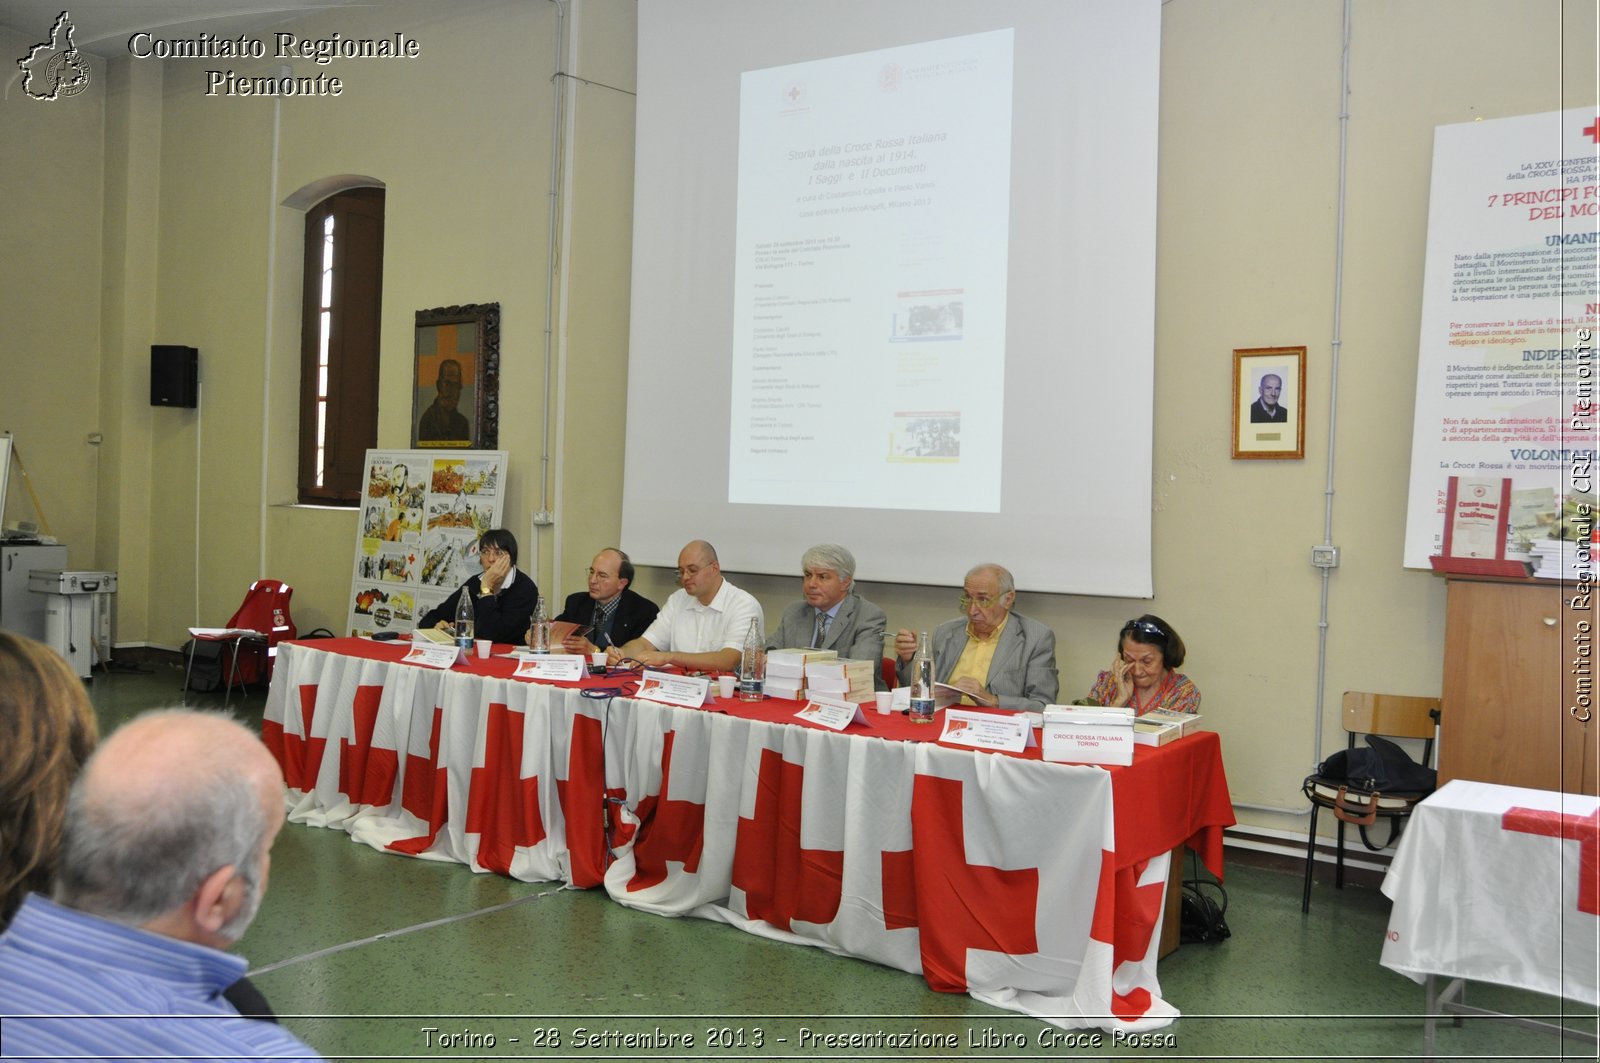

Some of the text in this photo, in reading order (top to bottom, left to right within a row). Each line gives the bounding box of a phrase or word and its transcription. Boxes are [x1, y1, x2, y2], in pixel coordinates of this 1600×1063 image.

[788, 132, 947, 160] Storia della Croce Rossa Italiana
[813, 159, 836, 171] dalla
[839, 155, 873, 168] nascita
[876, 154, 886, 163] al
[1534, 161, 1554, 169] XXV
[808, 176, 813, 185] I
[816, 174, 842, 184] Saggi
[861, 170, 870, 178] II
[872, 163, 926, 178] Documenti
[1528, 169, 1557, 178] CROCE
[1561, 166, 1591, 174] ROSSA
[1566, 176, 1580, 184] HA
[1488, 195, 1497, 208] 7
[1502, 187, 1578, 206] PRINCIPI
[1529, 206, 1565, 221] DEL
[1493, 250, 1551, 259] preoccupazione
[1497, 258, 1539, 266] Movimento
[1498, 265, 1552, 274] internazionale
[1506, 274, 1544, 282] sofferenze
[1471, 284, 1506, 294] rispettare
[1518, 283, 1548, 292] persona
[1460, 293, 1508, 302] cooperazione
[1533, 292, 1549, 300] pace
[1517, 319, 1543, 327] fiducia
[1522, 349, 1600, 361] INDIPENE
[1446, 382, 1477, 390] rispettivi
[1459, 426, 1511, 434] appartenenza
[1440, 461, 1449, 469] La
[1460, 512, 1495, 520] Uniforme
